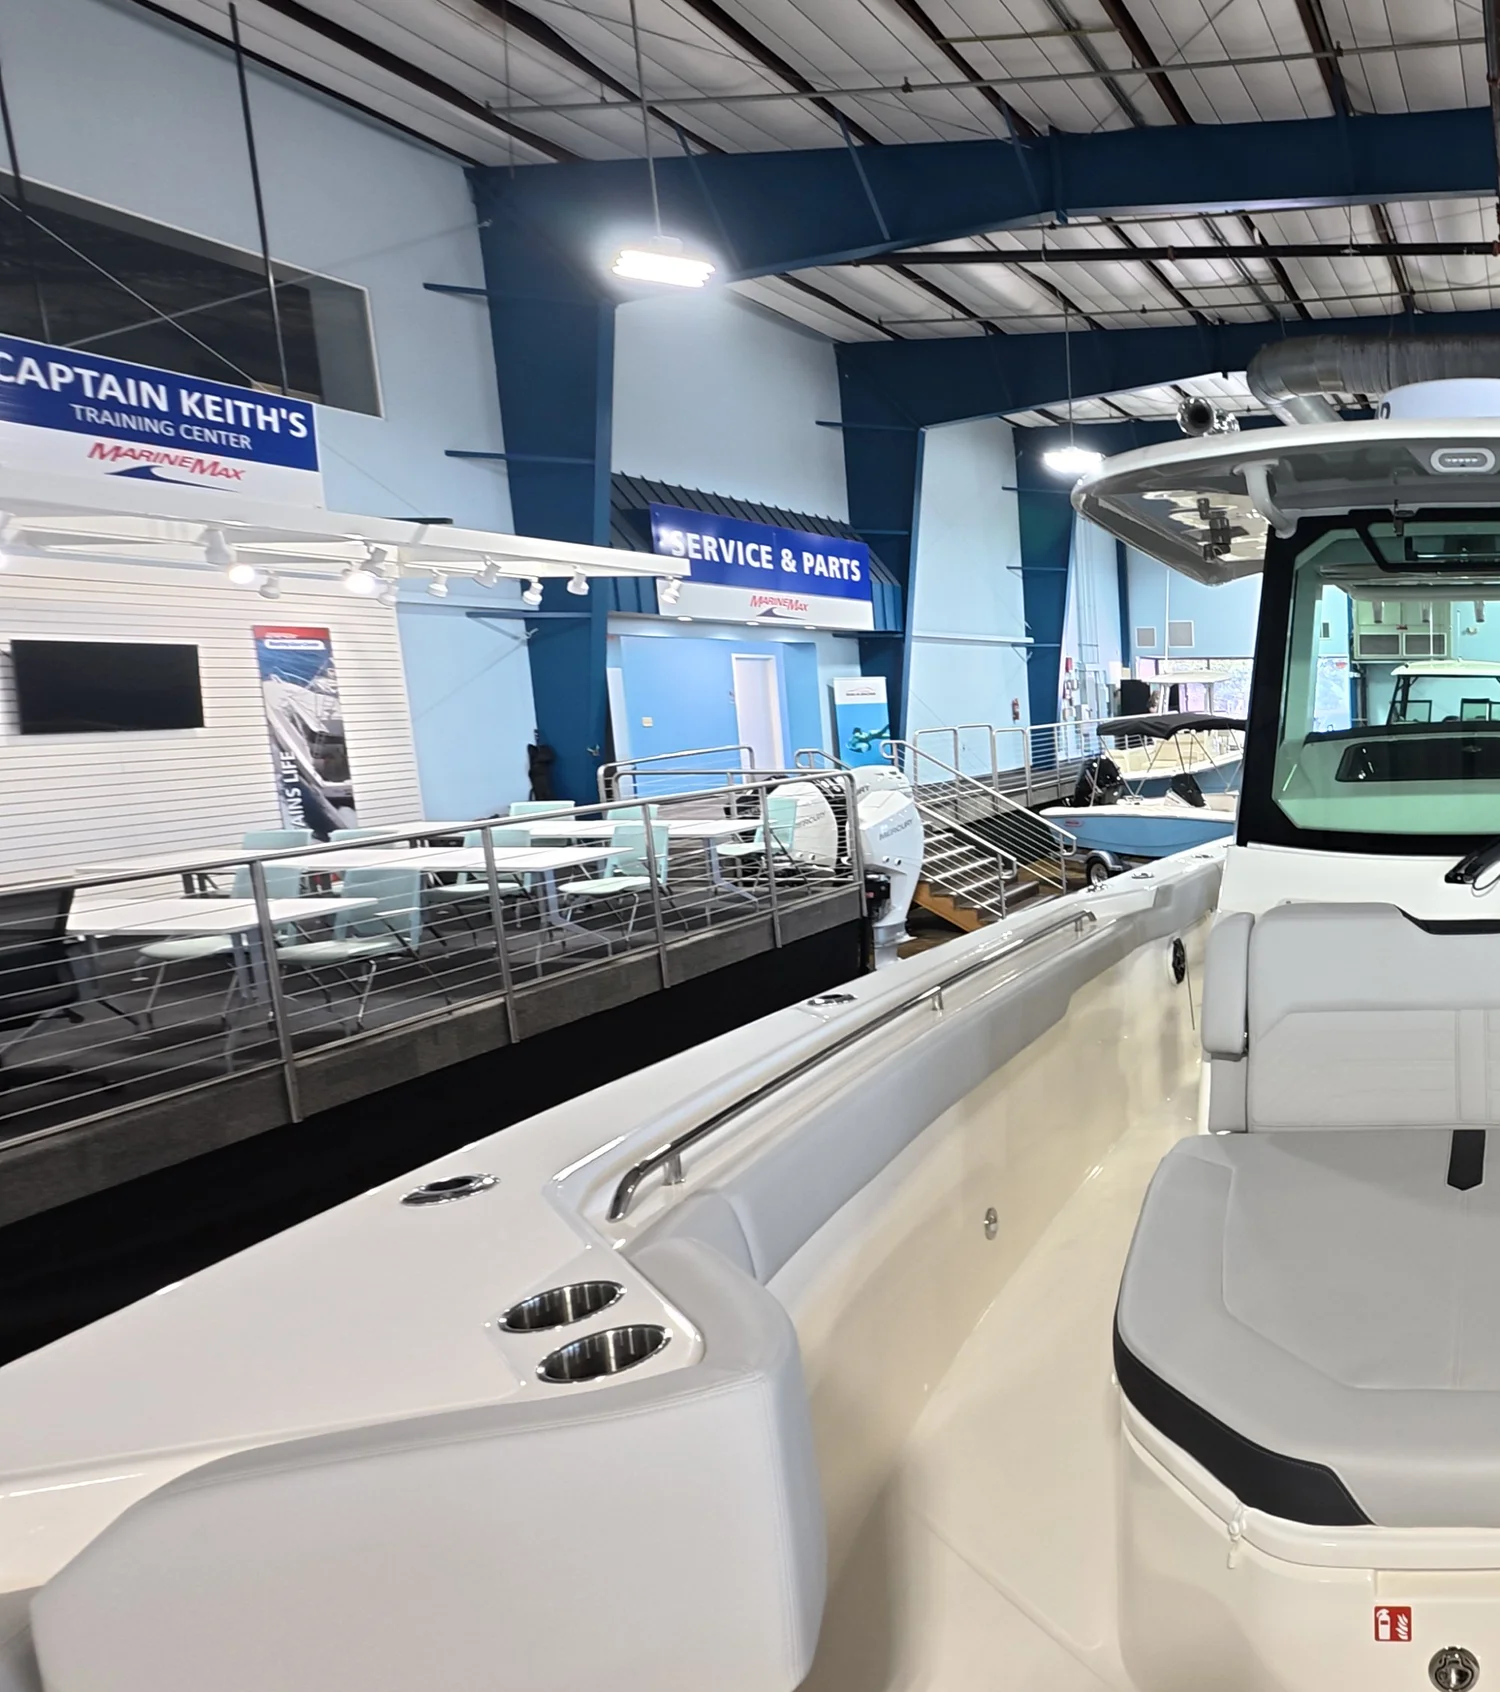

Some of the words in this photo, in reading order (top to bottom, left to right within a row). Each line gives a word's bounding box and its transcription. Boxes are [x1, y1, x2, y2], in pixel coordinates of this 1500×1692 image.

[0, 351, 170, 413] CAPTAIN
[179, 388, 308, 439] KEITH'S
[68, 403, 175, 437] TRAINING
[179, 424, 253, 451] CENTER
[671, 530, 774, 570] SERVICE
[780, 548, 798, 573] &
[802, 551, 861, 582] PARTS
[280, 751, 300, 783] LIFE
[285, 787, 307, 828] AINS
[879, 819, 913, 841] MERCURY
